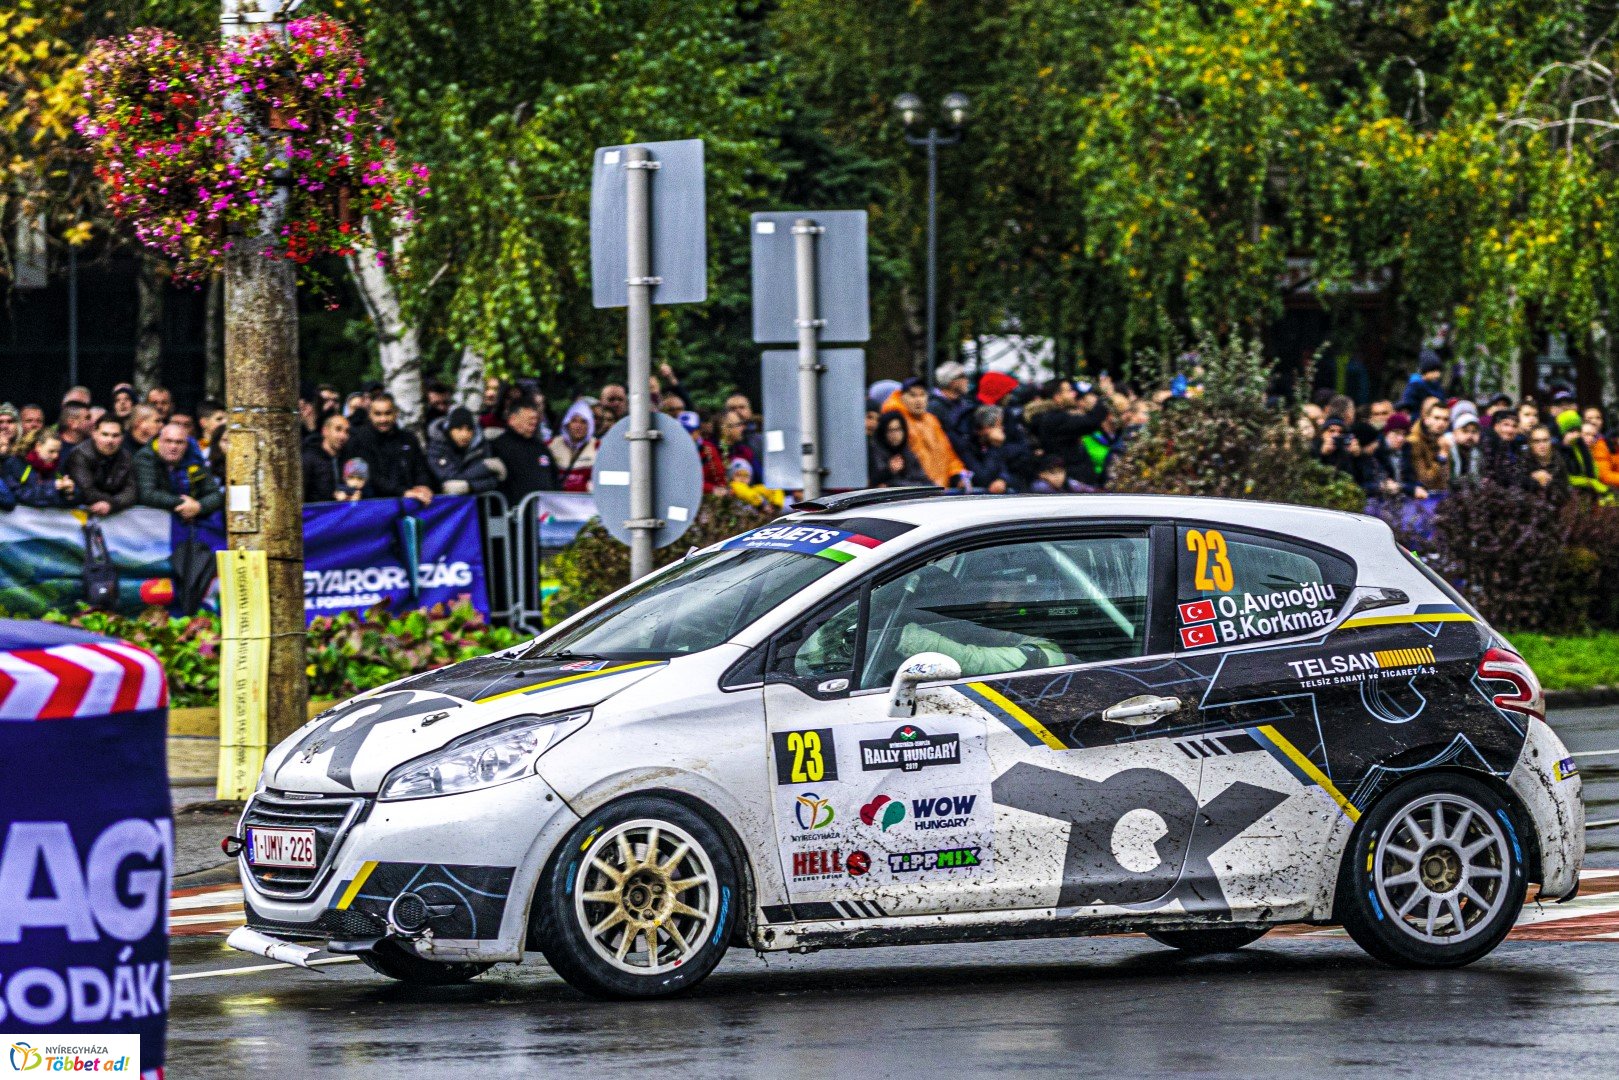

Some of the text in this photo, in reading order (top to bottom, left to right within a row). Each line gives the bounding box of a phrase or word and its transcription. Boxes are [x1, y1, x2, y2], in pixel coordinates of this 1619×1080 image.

[1186, 529, 1235, 592] 23
[1218, 581, 1337, 618] O.Avcıoğlu
[1219, 608, 1338, 642] B.Korkmaz
[1288, 652, 1380, 678] TELSAN
[787, 731, 824, 783] 23
[863, 747, 900, 764] RALLY
[903, 741, 957, 761] HUNGARY
[912, 795, 977, 818] WOW
[915, 817, 970, 831] HUNGARY
[792, 849, 842, 877] HELL
